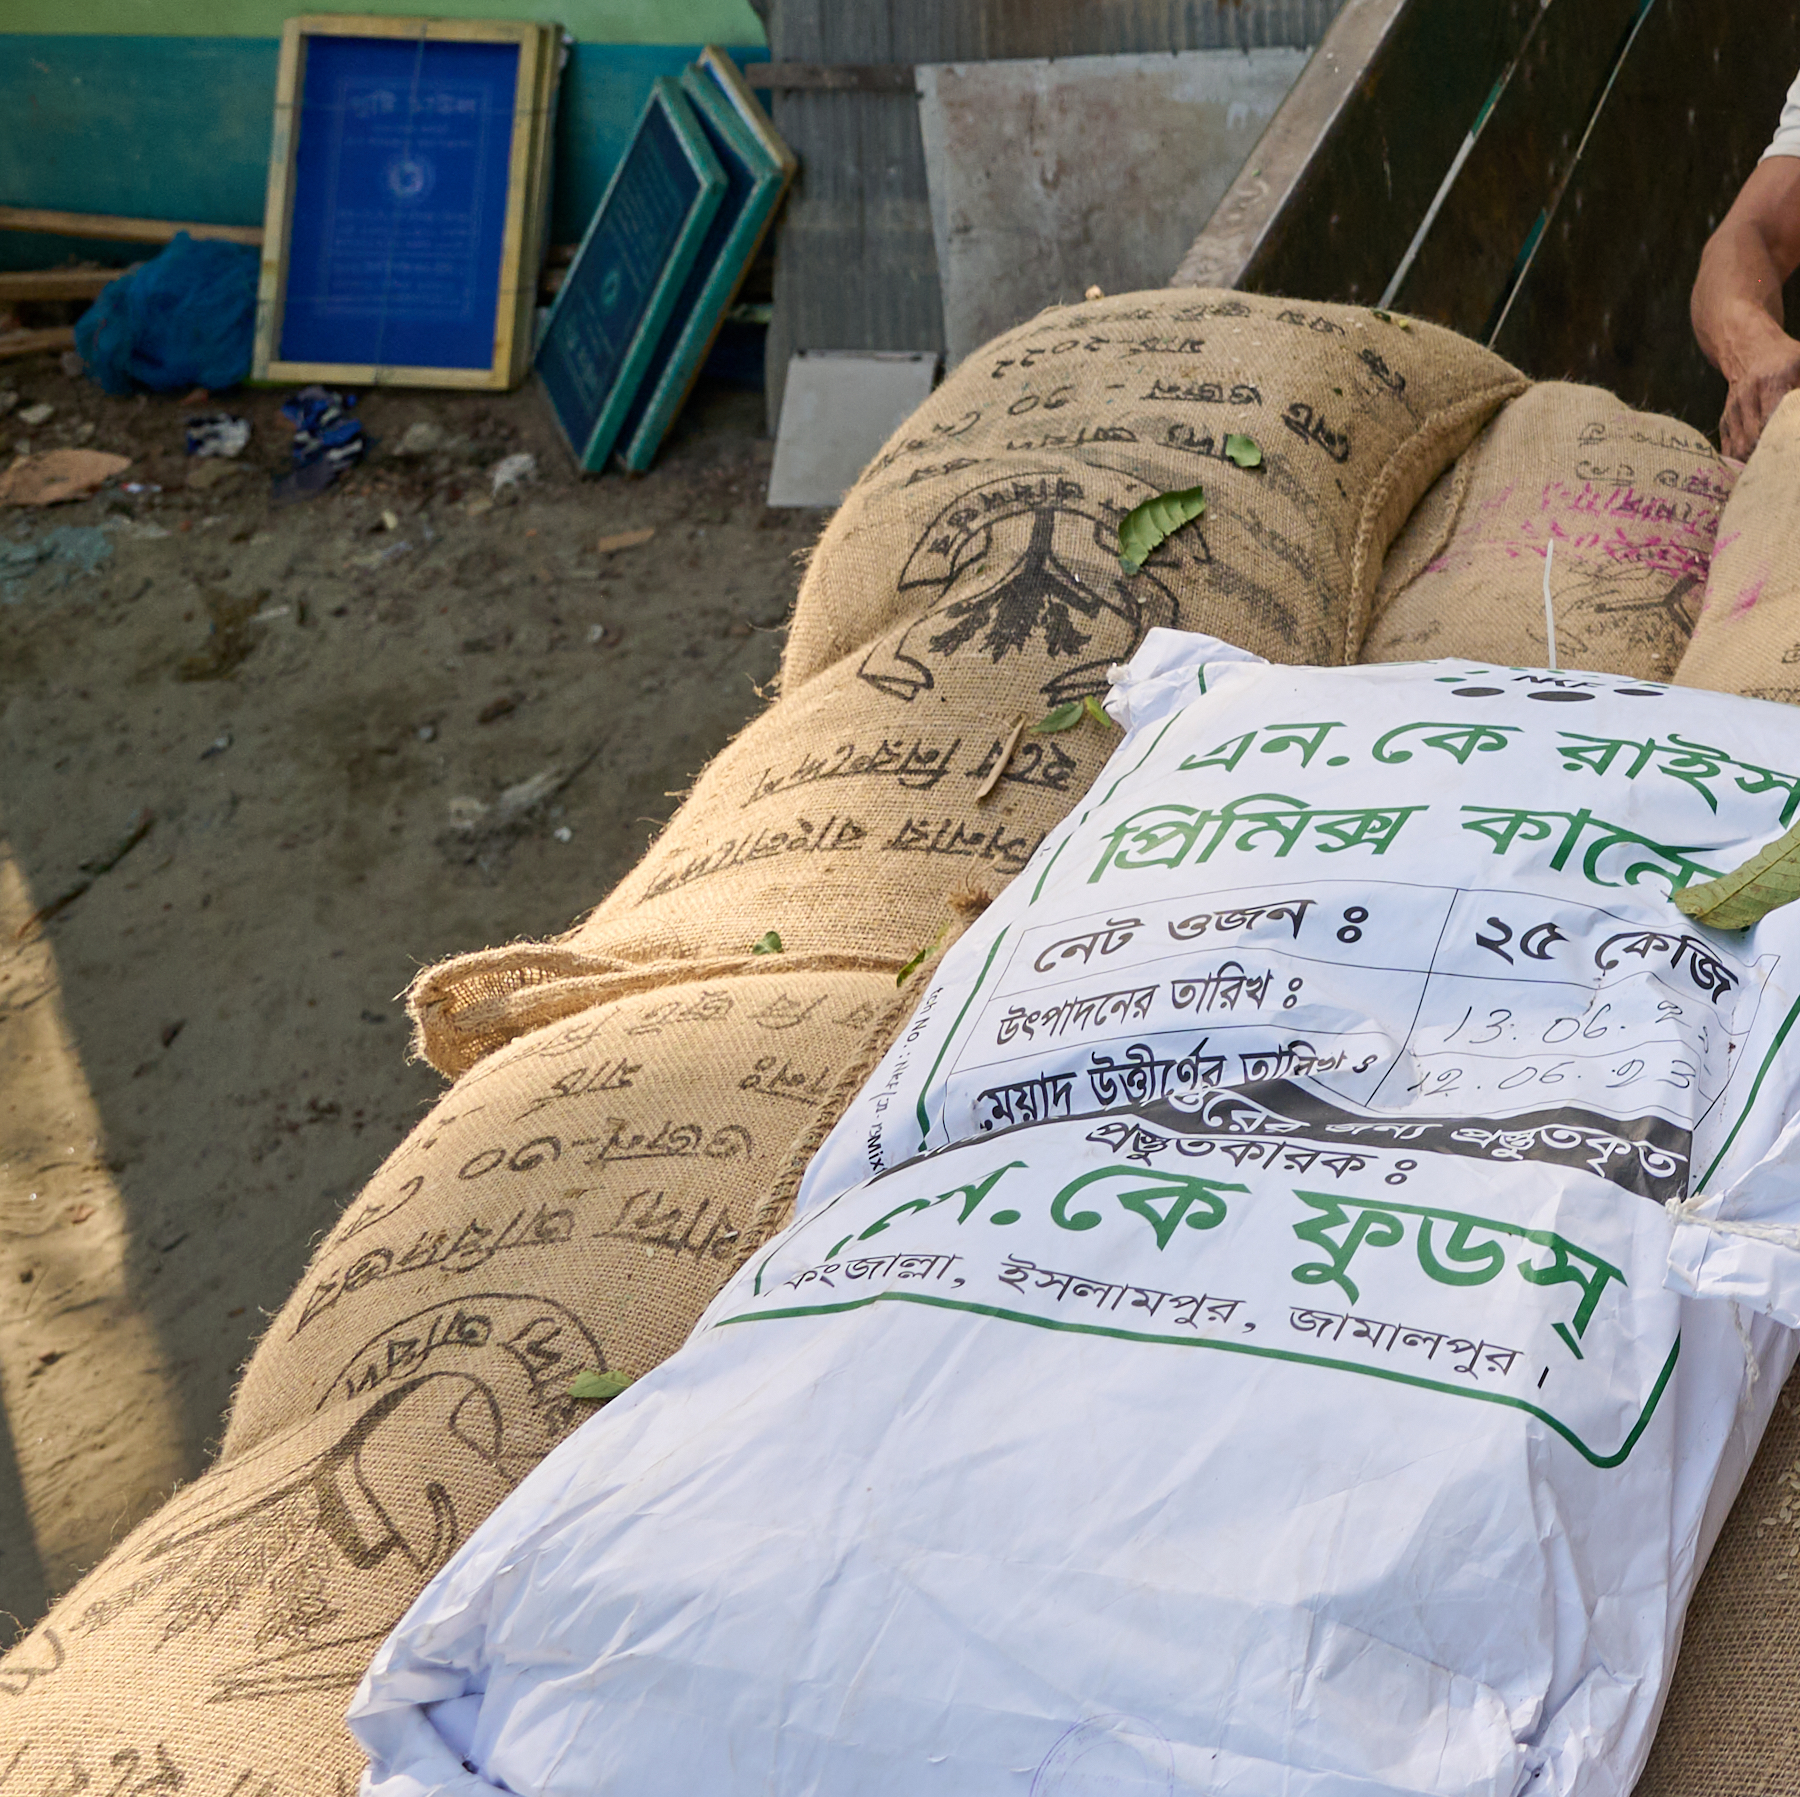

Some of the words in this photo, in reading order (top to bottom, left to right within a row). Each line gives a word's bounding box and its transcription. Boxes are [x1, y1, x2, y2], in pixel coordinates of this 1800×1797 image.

[1034, 917, 1135, 974] নেট
[1167, 897, 1318, 944] ওজন
[1475, 913, 1573, 967] ২৫
[998, 978, 1159, 1047] উৎপাদনের
[1171, 961, 1275, 1014] তারিখ
